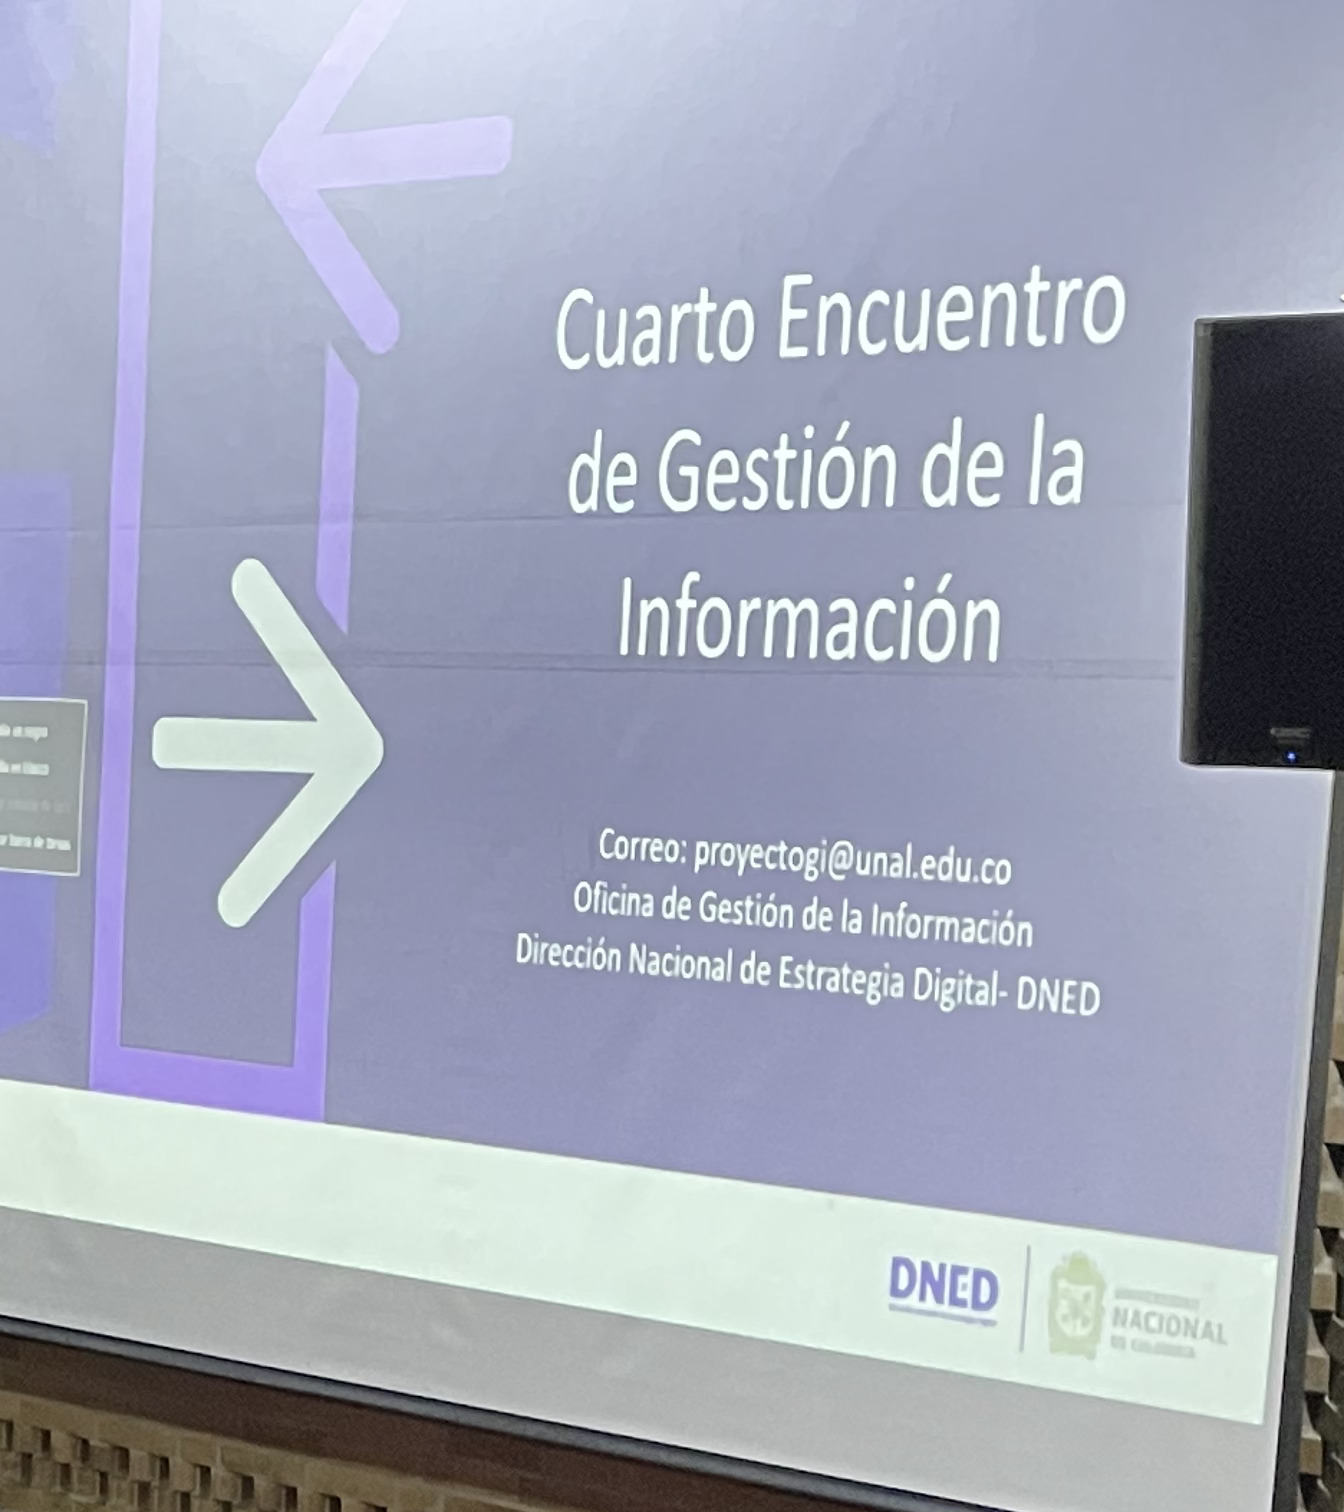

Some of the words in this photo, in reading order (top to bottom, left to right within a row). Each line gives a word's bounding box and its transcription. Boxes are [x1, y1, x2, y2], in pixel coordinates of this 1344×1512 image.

[556, 286, 755, 371] Cuarto
[778, 264, 1126, 359] Encuentro
[568, 428, 638, 514] de
[658, 420, 897, 513] Gestión
[922, 415, 1005, 508] de
[1028, 412, 1085, 506] la
[619, 571, 1001, 664] Información
[599, 827, 688, 865] Correo:
[693, 838, 1012, 886] proyectogi@unal.edu.co
[573, 881, 655, 918] Oficina
[662, 885, 692, 922] de
[698, 890, 794, 930] Gestión
[801, 896, 834, 933] de
[840, 897, 863, 936] la
[871, 902, 1033, 948] Información
[516, 932, 621, 973] Dirección
[628, 942, 733, 983] Nacional
[740, 949, 772, 987] de
[778, 955, 906, 1007] Estrategia
[913, 966, 1010, 1013] Digital-
[1017, 975, 1101, 1017] DNED
[889, 1256, 999, 1312] DNED
[1111, 1305, 1229, 1346] NACIONAL
